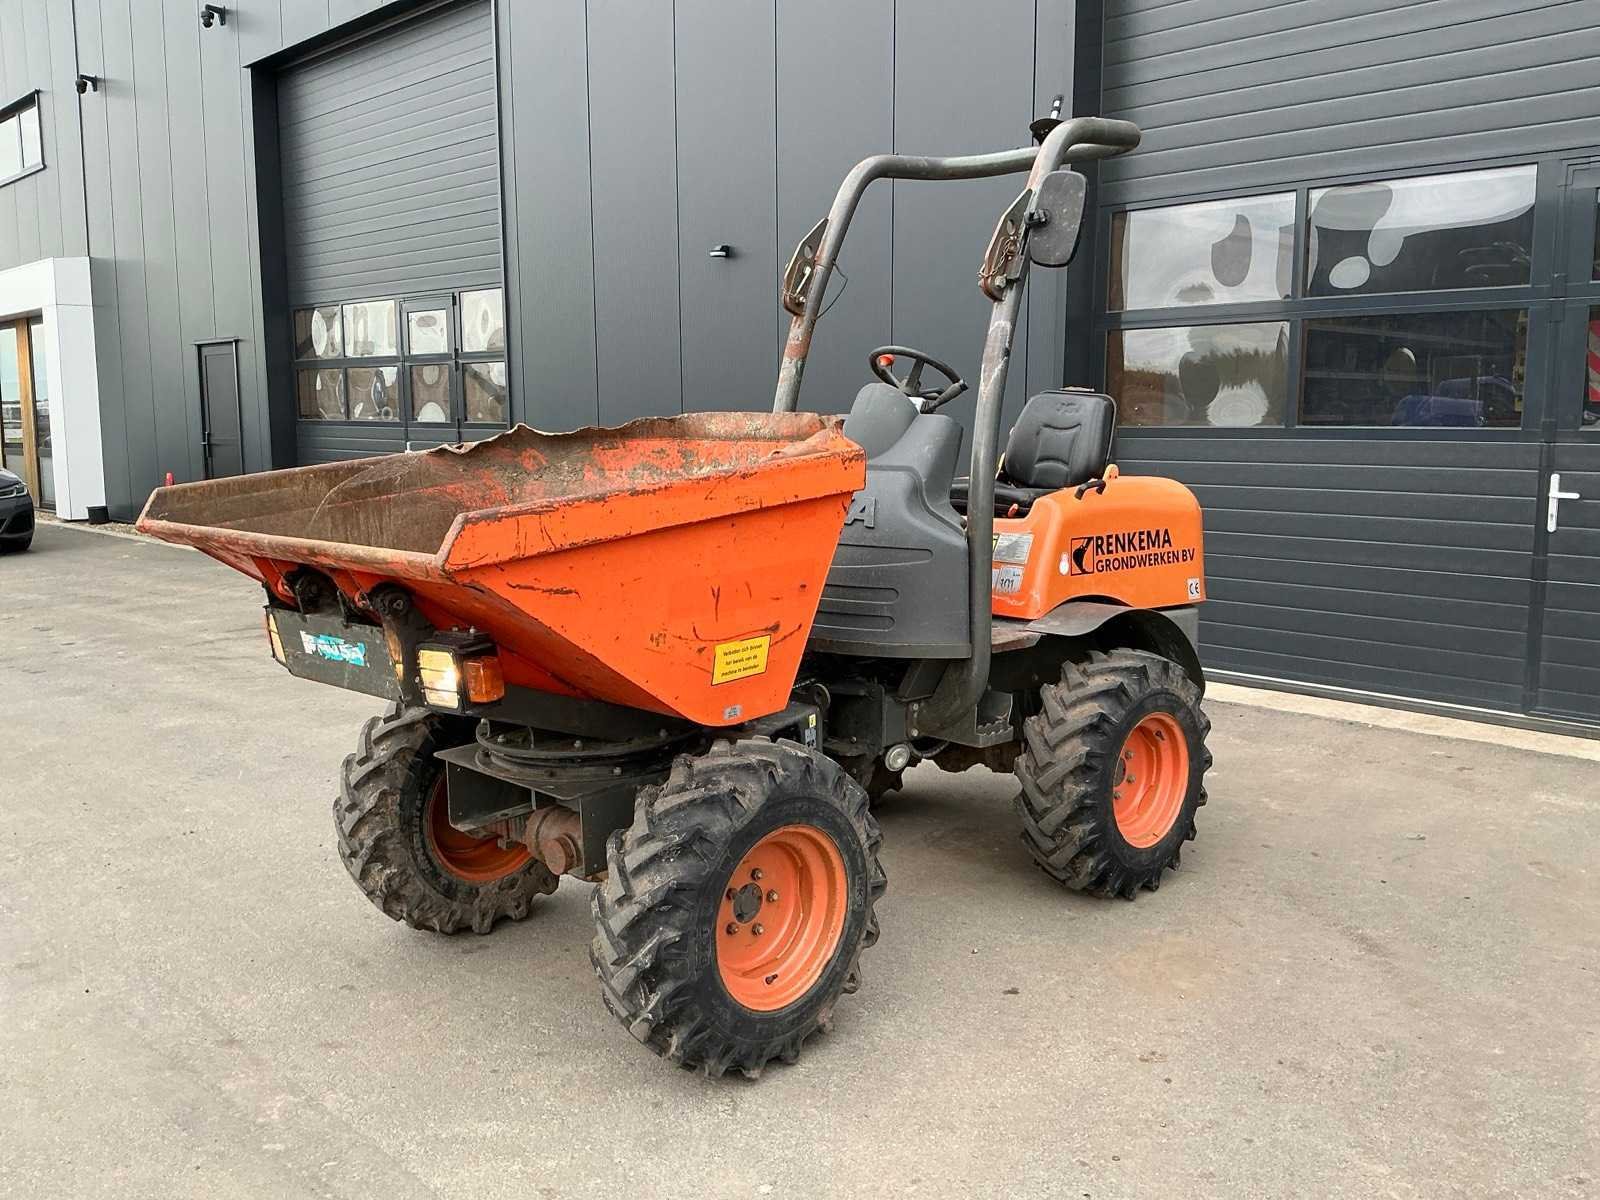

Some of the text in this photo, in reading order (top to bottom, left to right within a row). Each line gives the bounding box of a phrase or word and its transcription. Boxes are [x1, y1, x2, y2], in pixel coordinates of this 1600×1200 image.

[1095, 528, 1172, 556] RENKEMA
[1096, 547, 1195, 573] GRONDWERKEN BV
